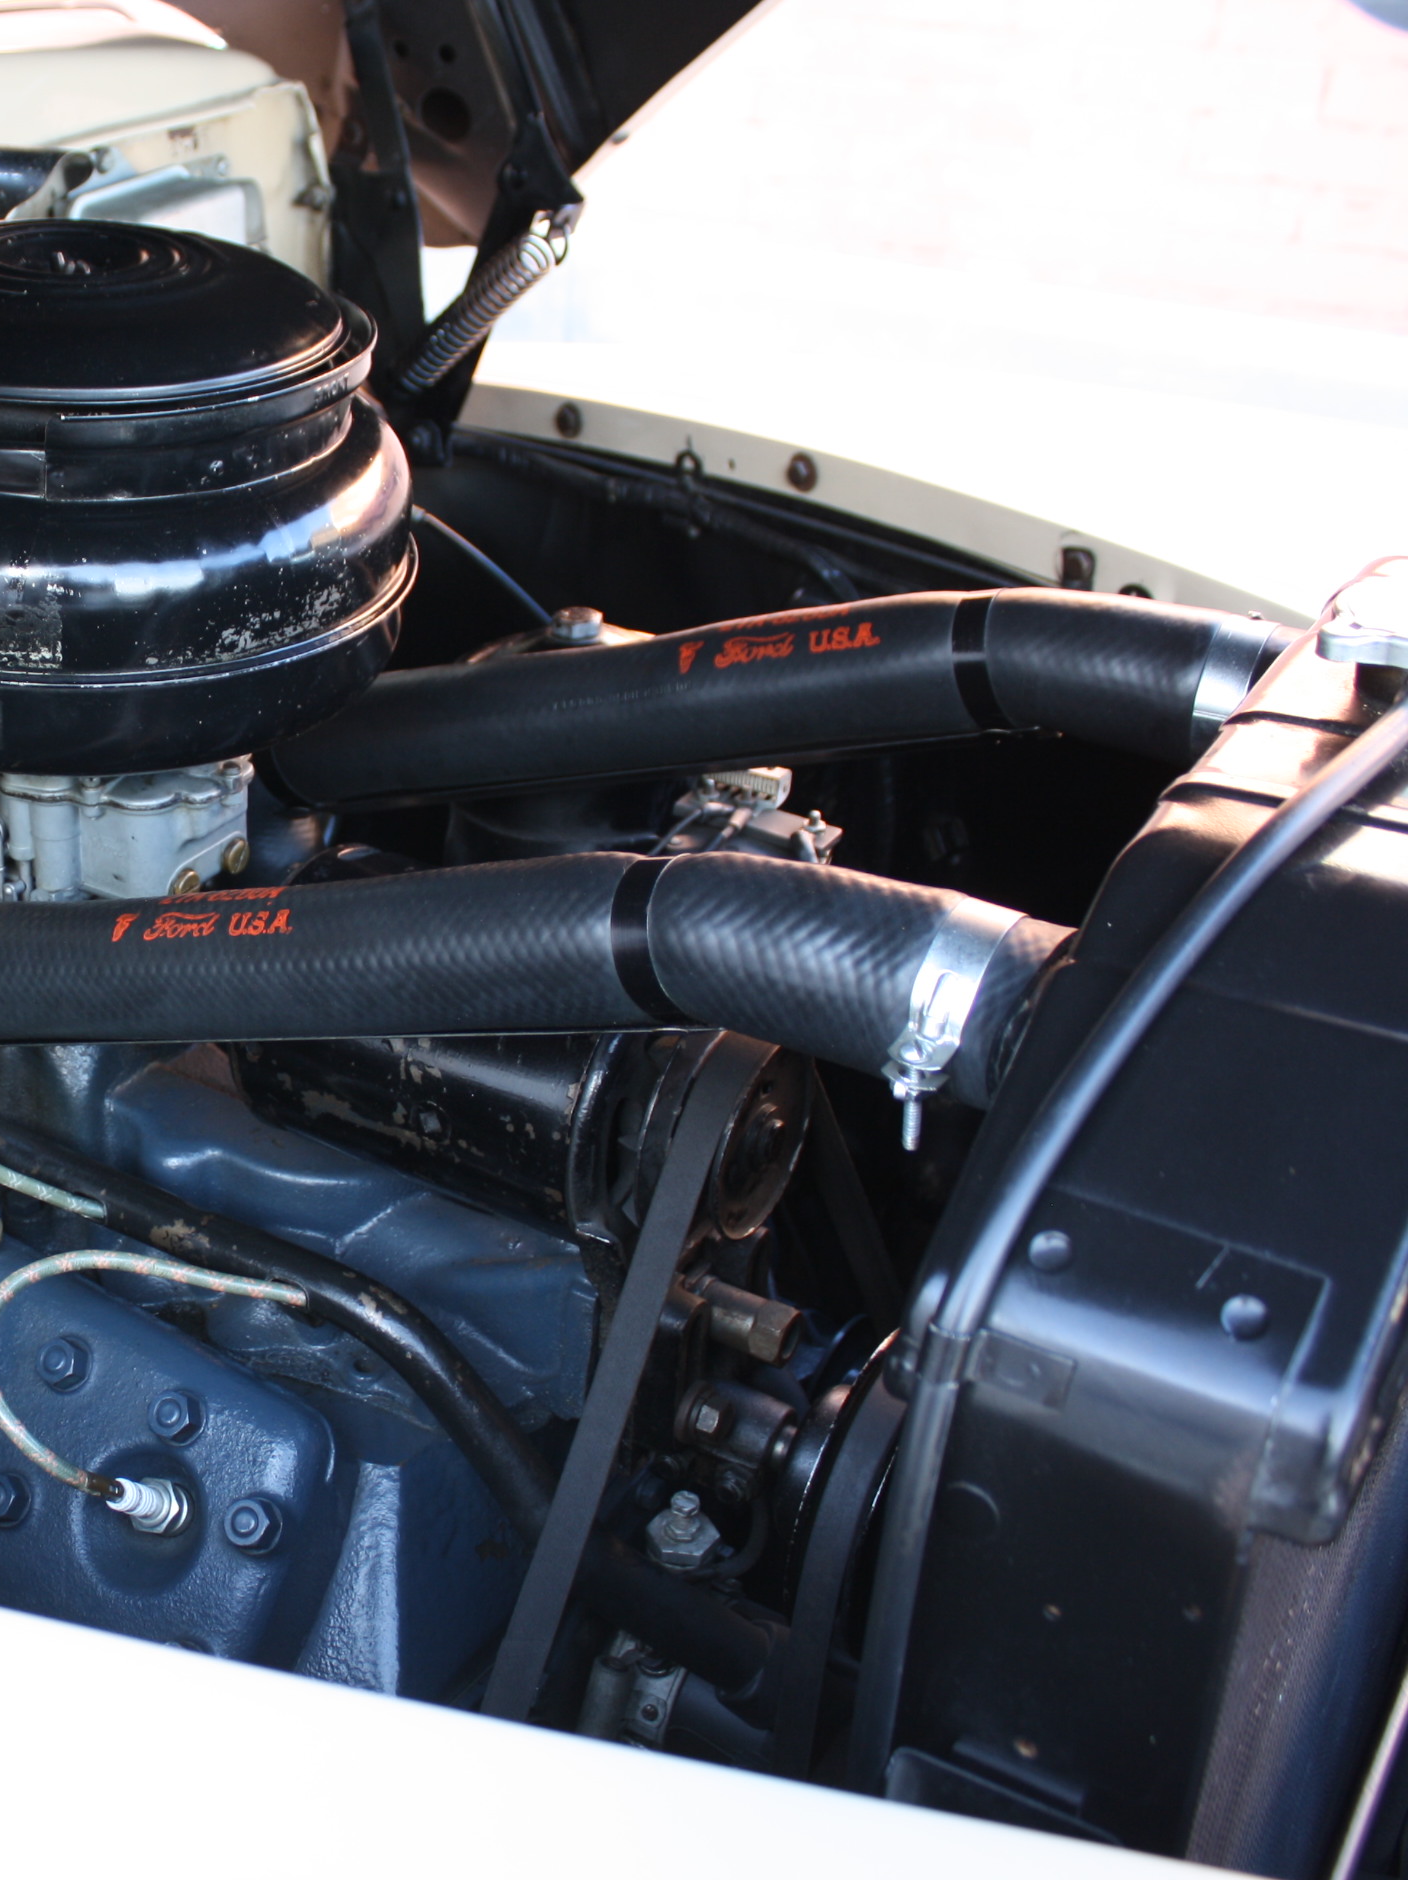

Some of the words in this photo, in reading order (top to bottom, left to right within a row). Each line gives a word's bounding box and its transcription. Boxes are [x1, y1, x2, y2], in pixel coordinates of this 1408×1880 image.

[714, 632, 795, 668] Ford
[144, 912, 220, 941] Ford
[228, 908, 294, 937] U.S.A.
